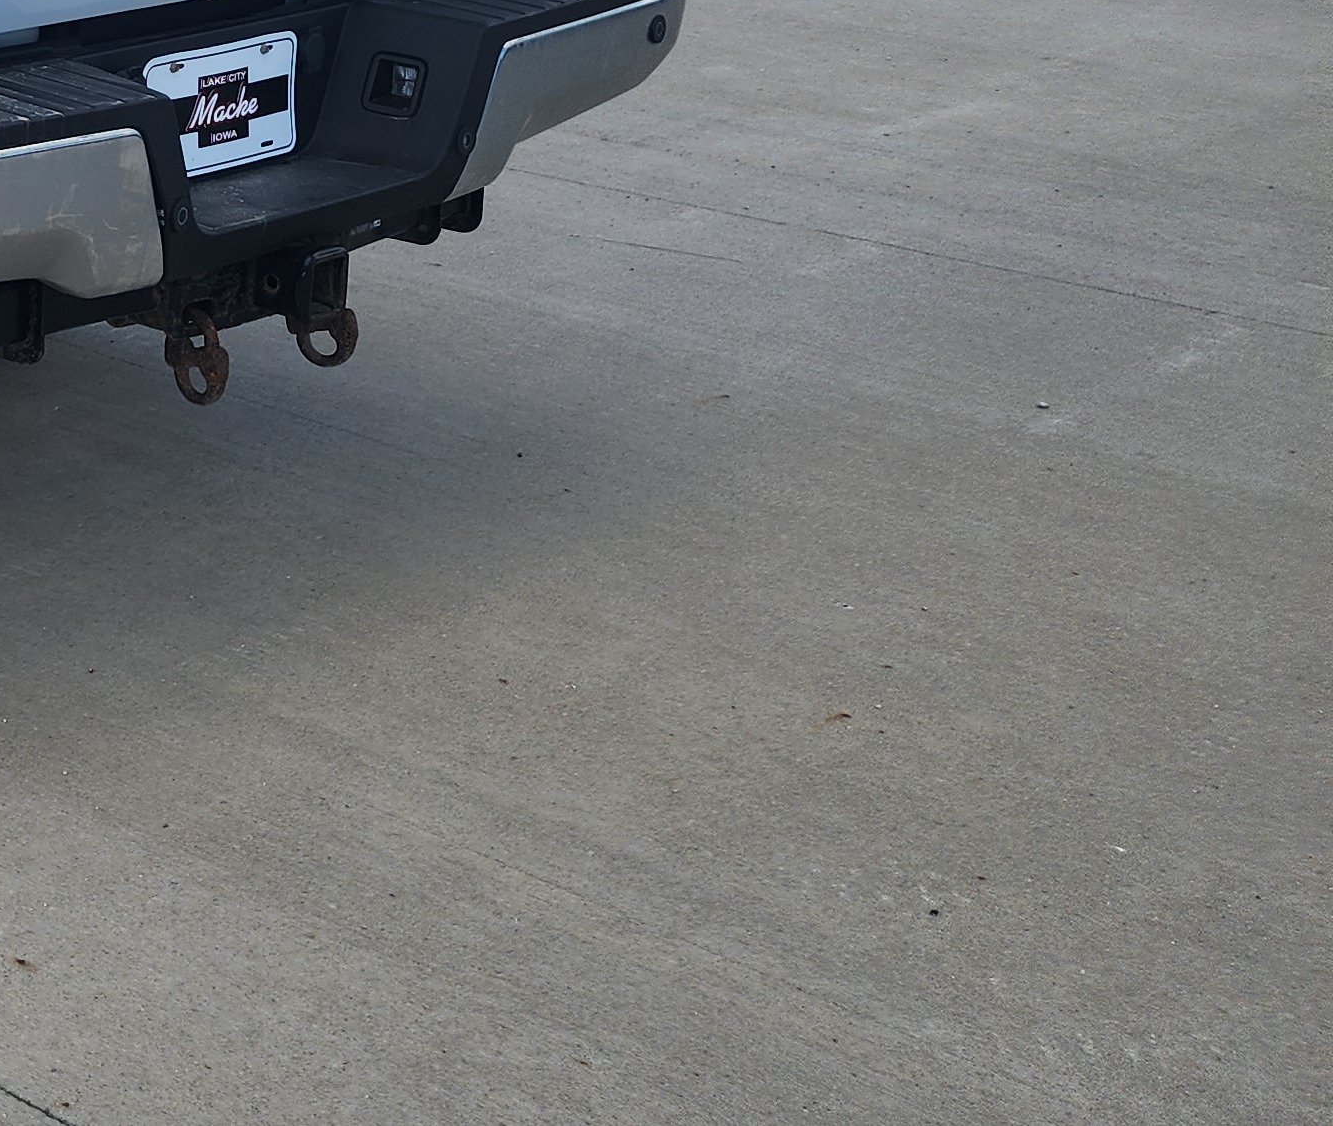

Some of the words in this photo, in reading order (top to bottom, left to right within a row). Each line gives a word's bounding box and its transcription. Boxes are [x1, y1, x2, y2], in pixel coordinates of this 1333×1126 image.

[202, 75, 227, 88] LAKE
[228, 70, 247, 83] CITY
[188, 85, 259, 129] Macke
[212, 129, 238, 143] IOWA
